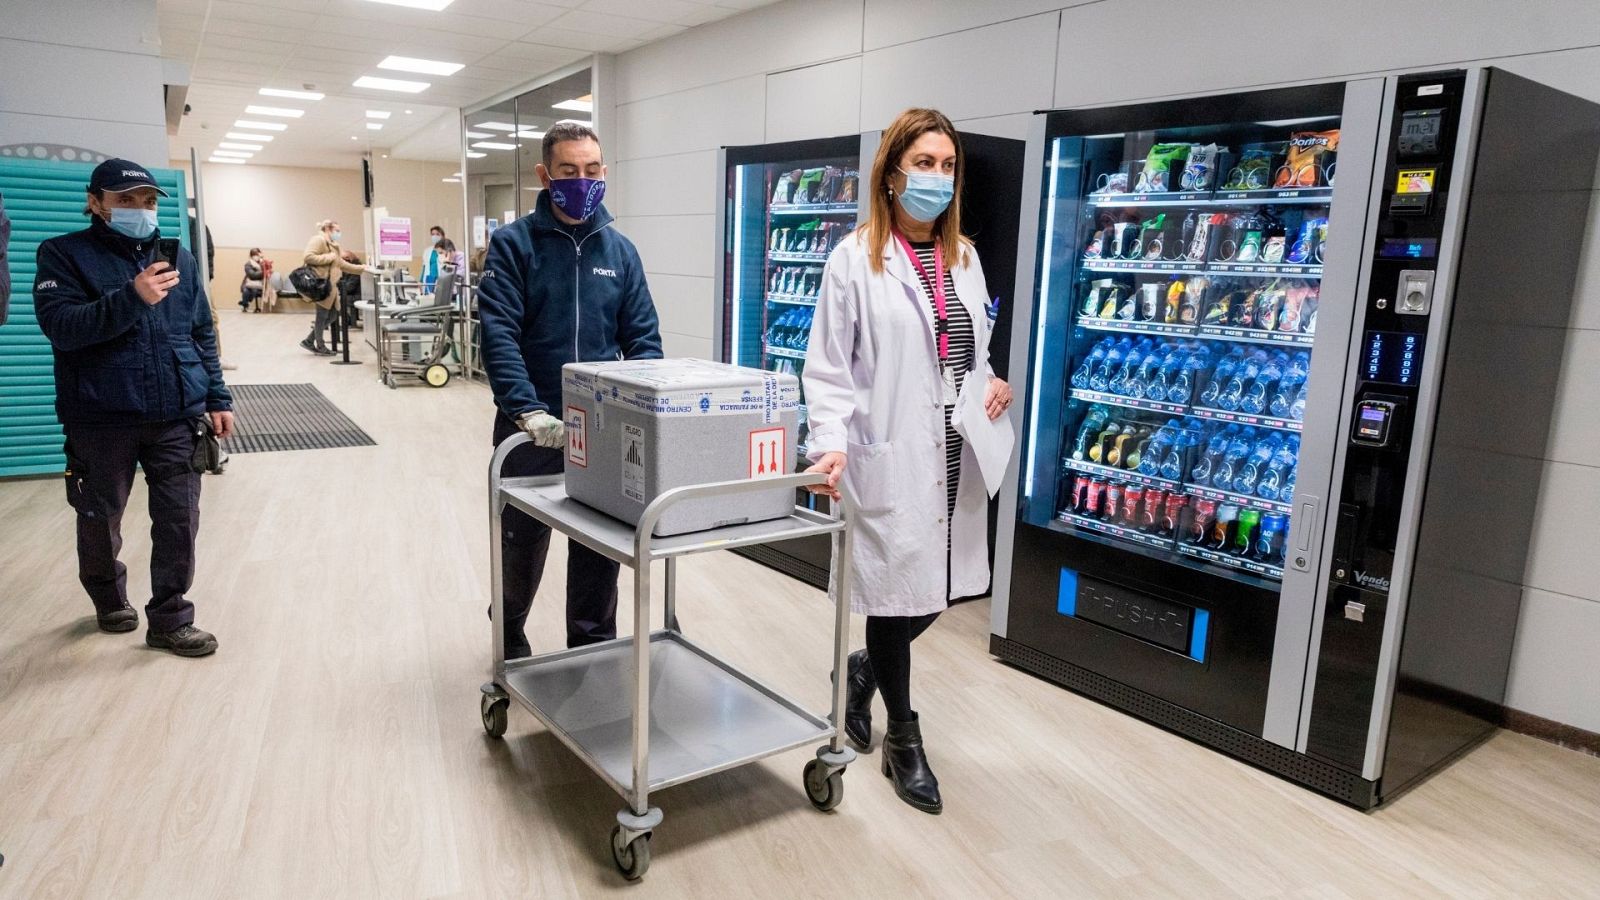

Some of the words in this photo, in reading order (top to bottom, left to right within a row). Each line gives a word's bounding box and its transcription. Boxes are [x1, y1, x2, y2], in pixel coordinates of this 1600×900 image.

[1289, 137, 1329, 147] Doritos
[121, 170, 150, 179] PORTA
[592, 267, 616, 278] PORTA
[37, 280, 58, 290] ORTA
[646, 402, 665, 414] MILITAR
[781, 400, 799, 408] ENTRO
[1353, 570, 1389, 587] Vendo
[1103, 596, 1158, 627] PUSH
